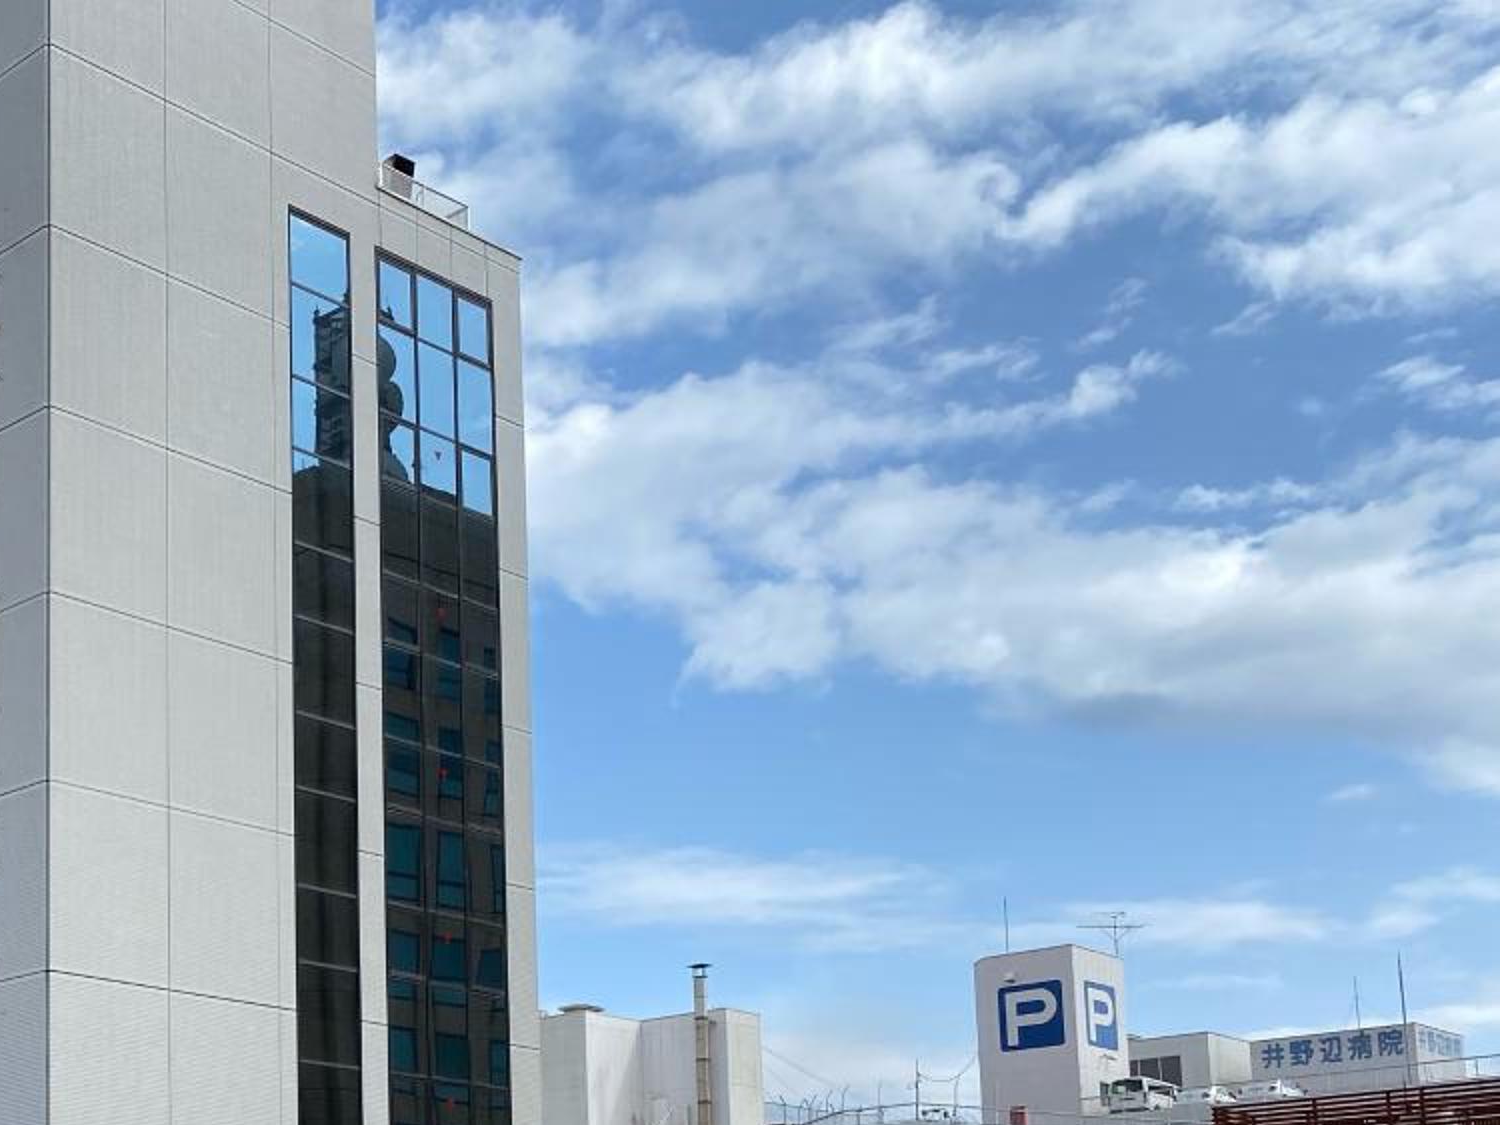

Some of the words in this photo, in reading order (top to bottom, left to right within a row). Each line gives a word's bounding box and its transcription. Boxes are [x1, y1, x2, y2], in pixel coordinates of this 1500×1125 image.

[1004, 986, 1057, 1047] P
[1087, 986, 1114, 1043] P
[1261, 1028, 1404, 1069] 井野辺病院
